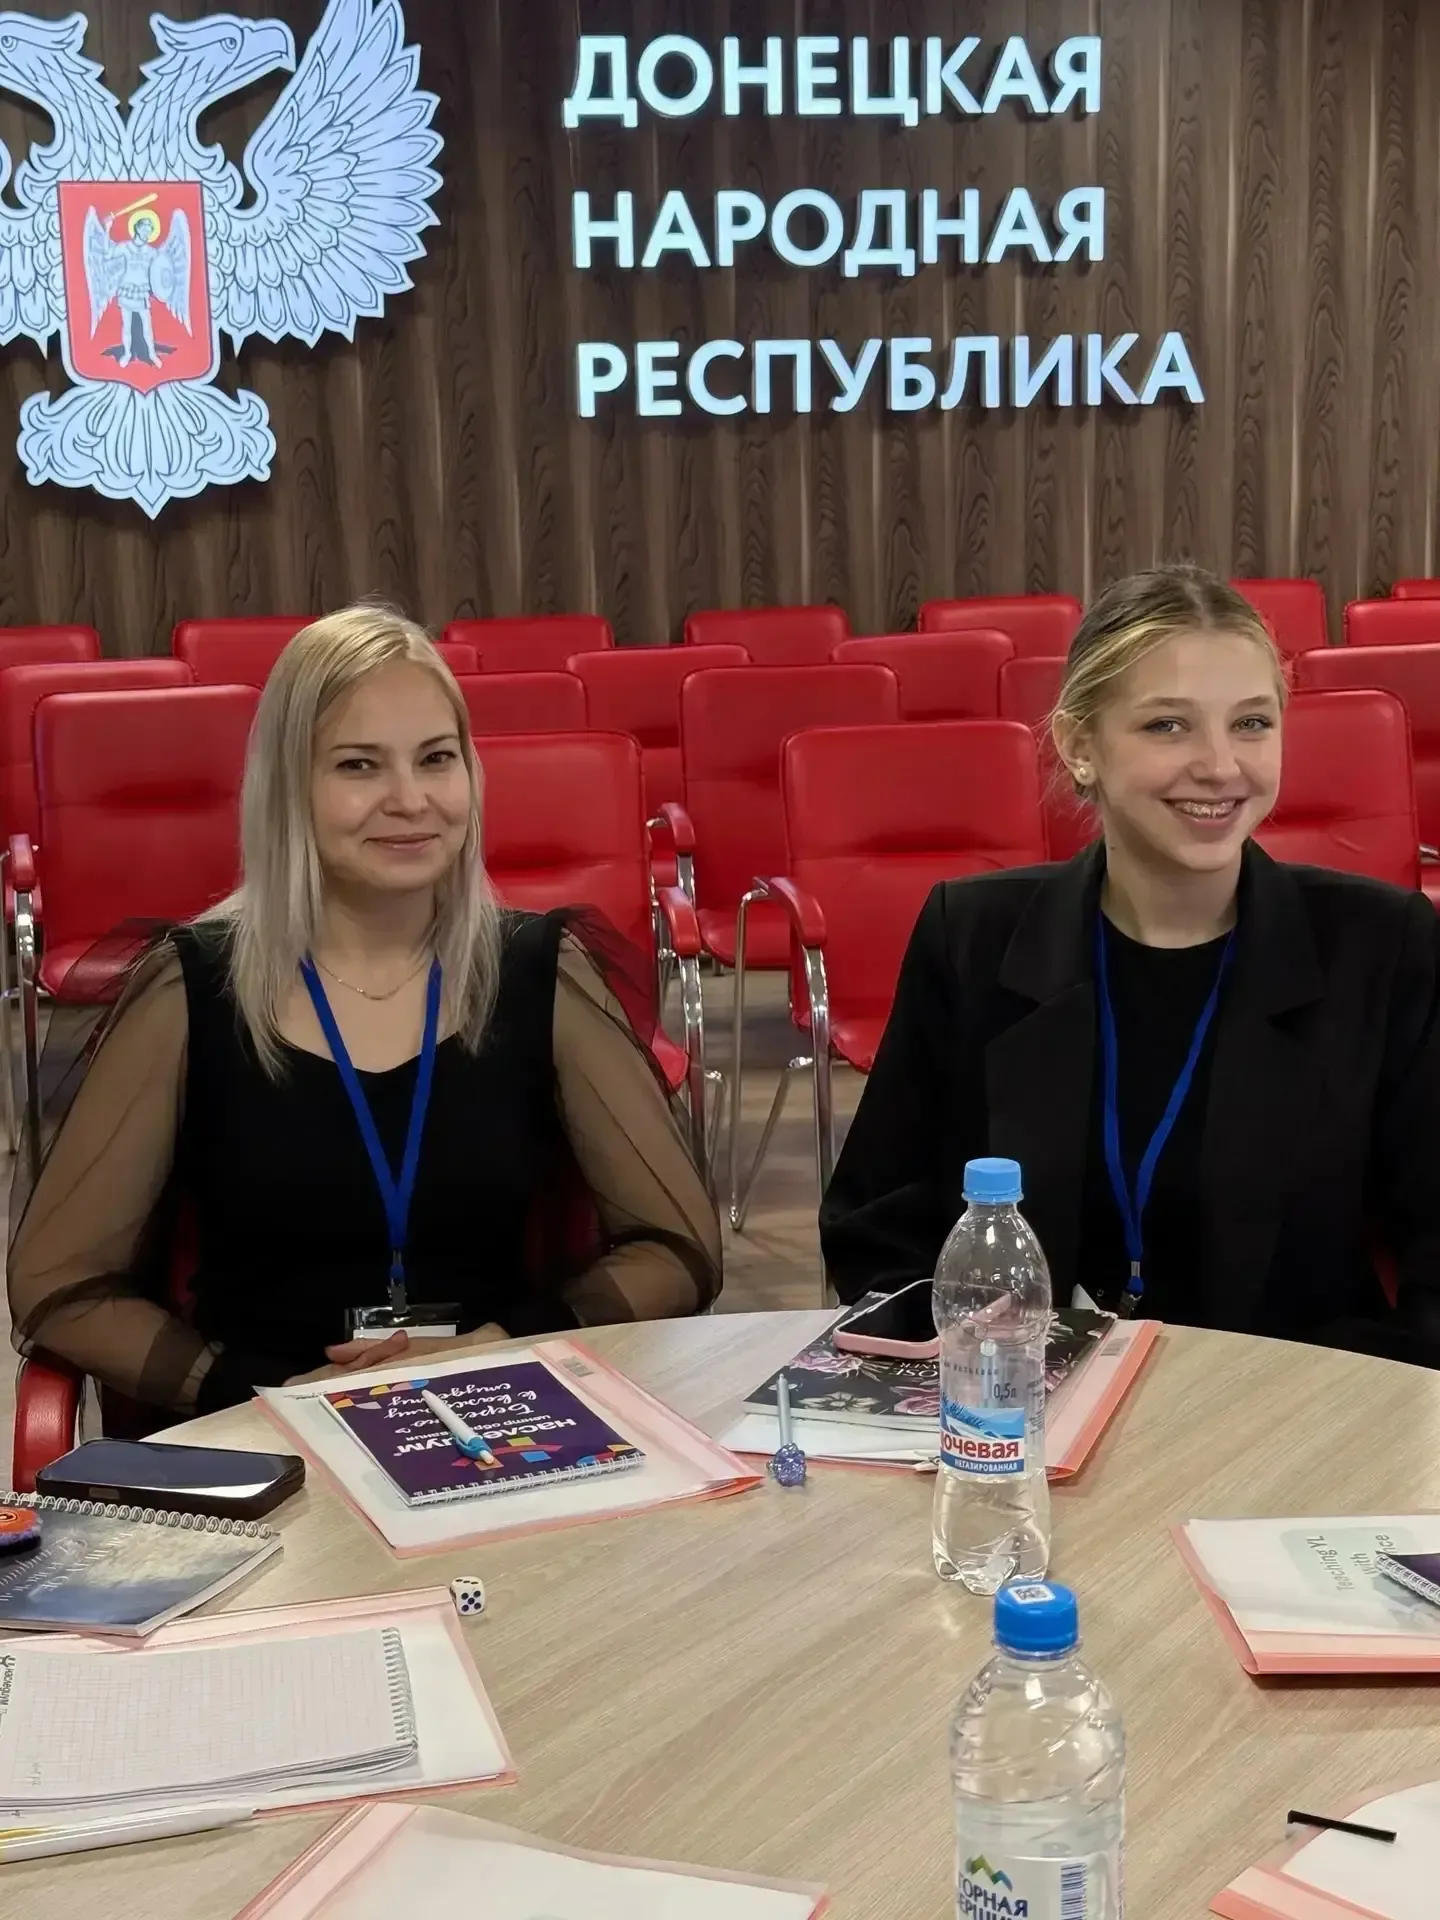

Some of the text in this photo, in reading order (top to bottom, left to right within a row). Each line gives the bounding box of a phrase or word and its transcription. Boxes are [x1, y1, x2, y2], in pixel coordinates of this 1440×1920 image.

[563, 35, 1102, 128] ДОНЕЦКАЯ
[573, 186, 1105, 278] НАРОДНАЯ
[576, 331, 1205, 418] РЕСПУБЛИКА
[888, 1368, 938, 1378] OSE
[993, 1383, 1017, 1401] 0,5л
[396, 1418, 577, 1453] наслеиум
[940, 1433, 1019, 1459] ючевая
[954, 1459, 1018, 1472] НЕГАЗИРОВАННАЯ
[1315, 1549, 1355, 1591] Teaching
